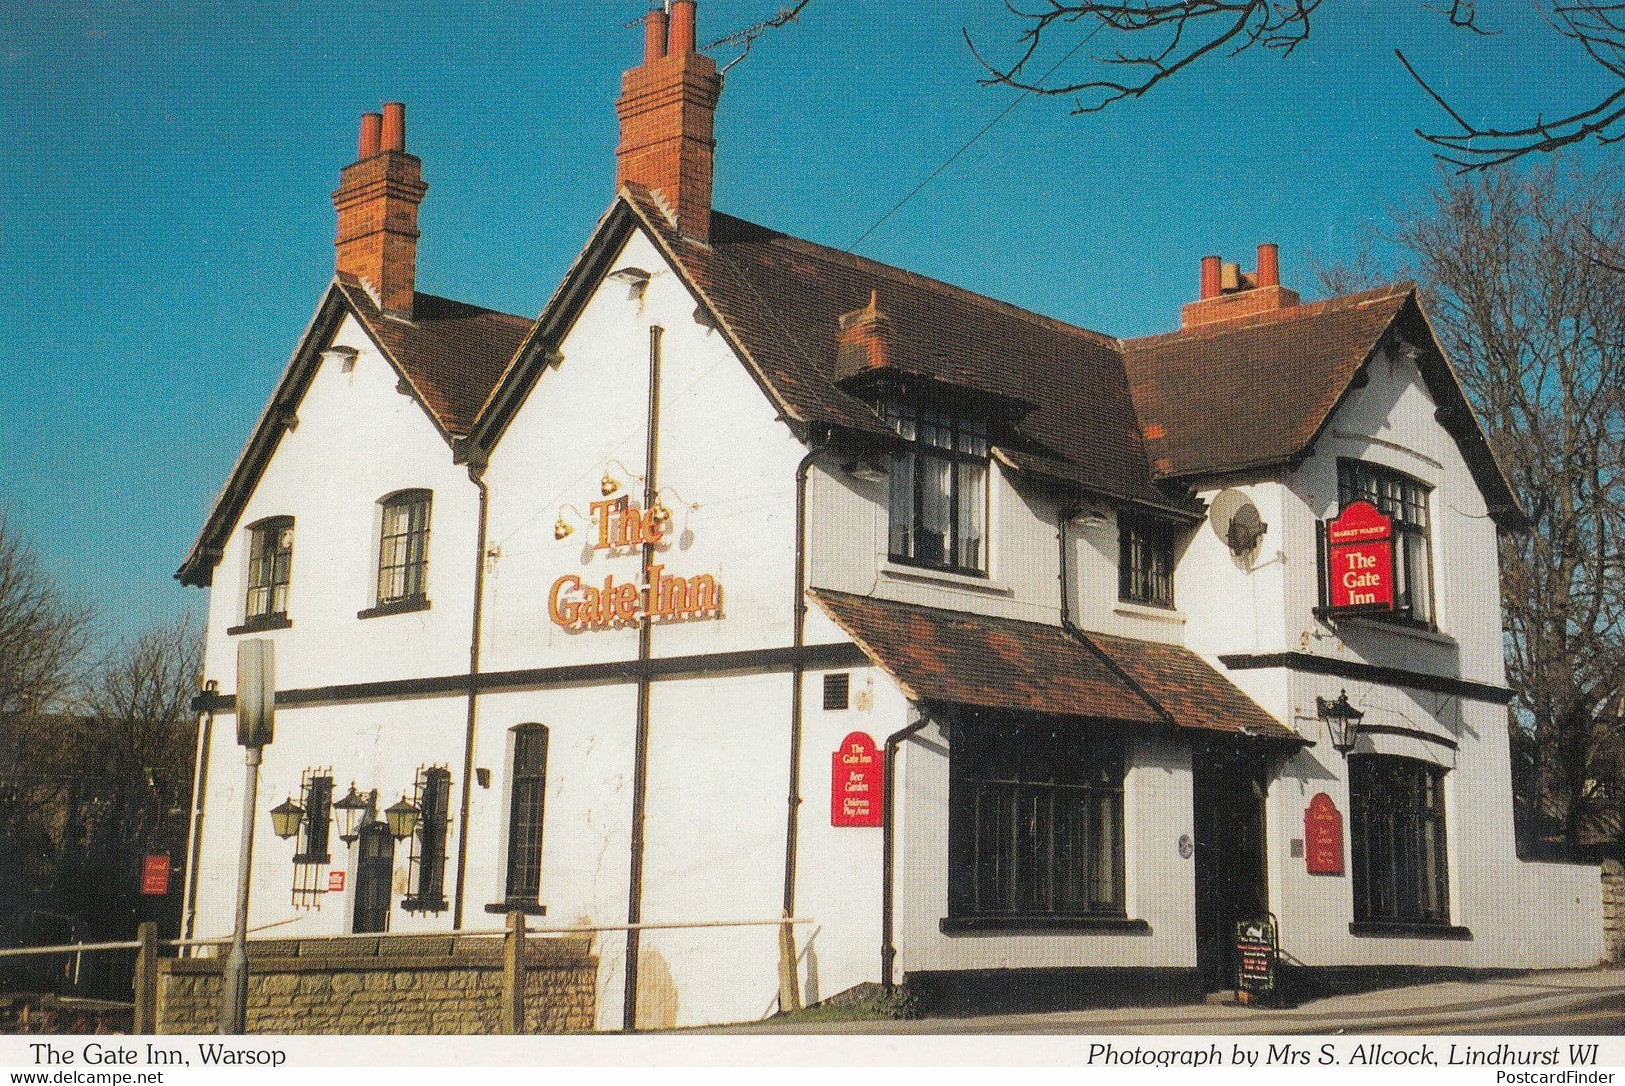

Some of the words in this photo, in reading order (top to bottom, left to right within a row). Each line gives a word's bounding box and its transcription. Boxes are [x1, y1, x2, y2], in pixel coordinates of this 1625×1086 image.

[589, 495, 664, 550] The
[1346, 552, 1376, 570] The
[1342, 571, 1380, 588] Gate
[548, 573, 639, 627] Gate
[644, 564, 718, 616] Inn
[1348, 590, 1376, 605] Inn
[850, 744, 864, 753] The
[843, 755, 859, 764] Gate
[860, 755, 872, 764] Inn
[850, 771, 864, 781] Beer
[844, 782, 869, 792] Garden
